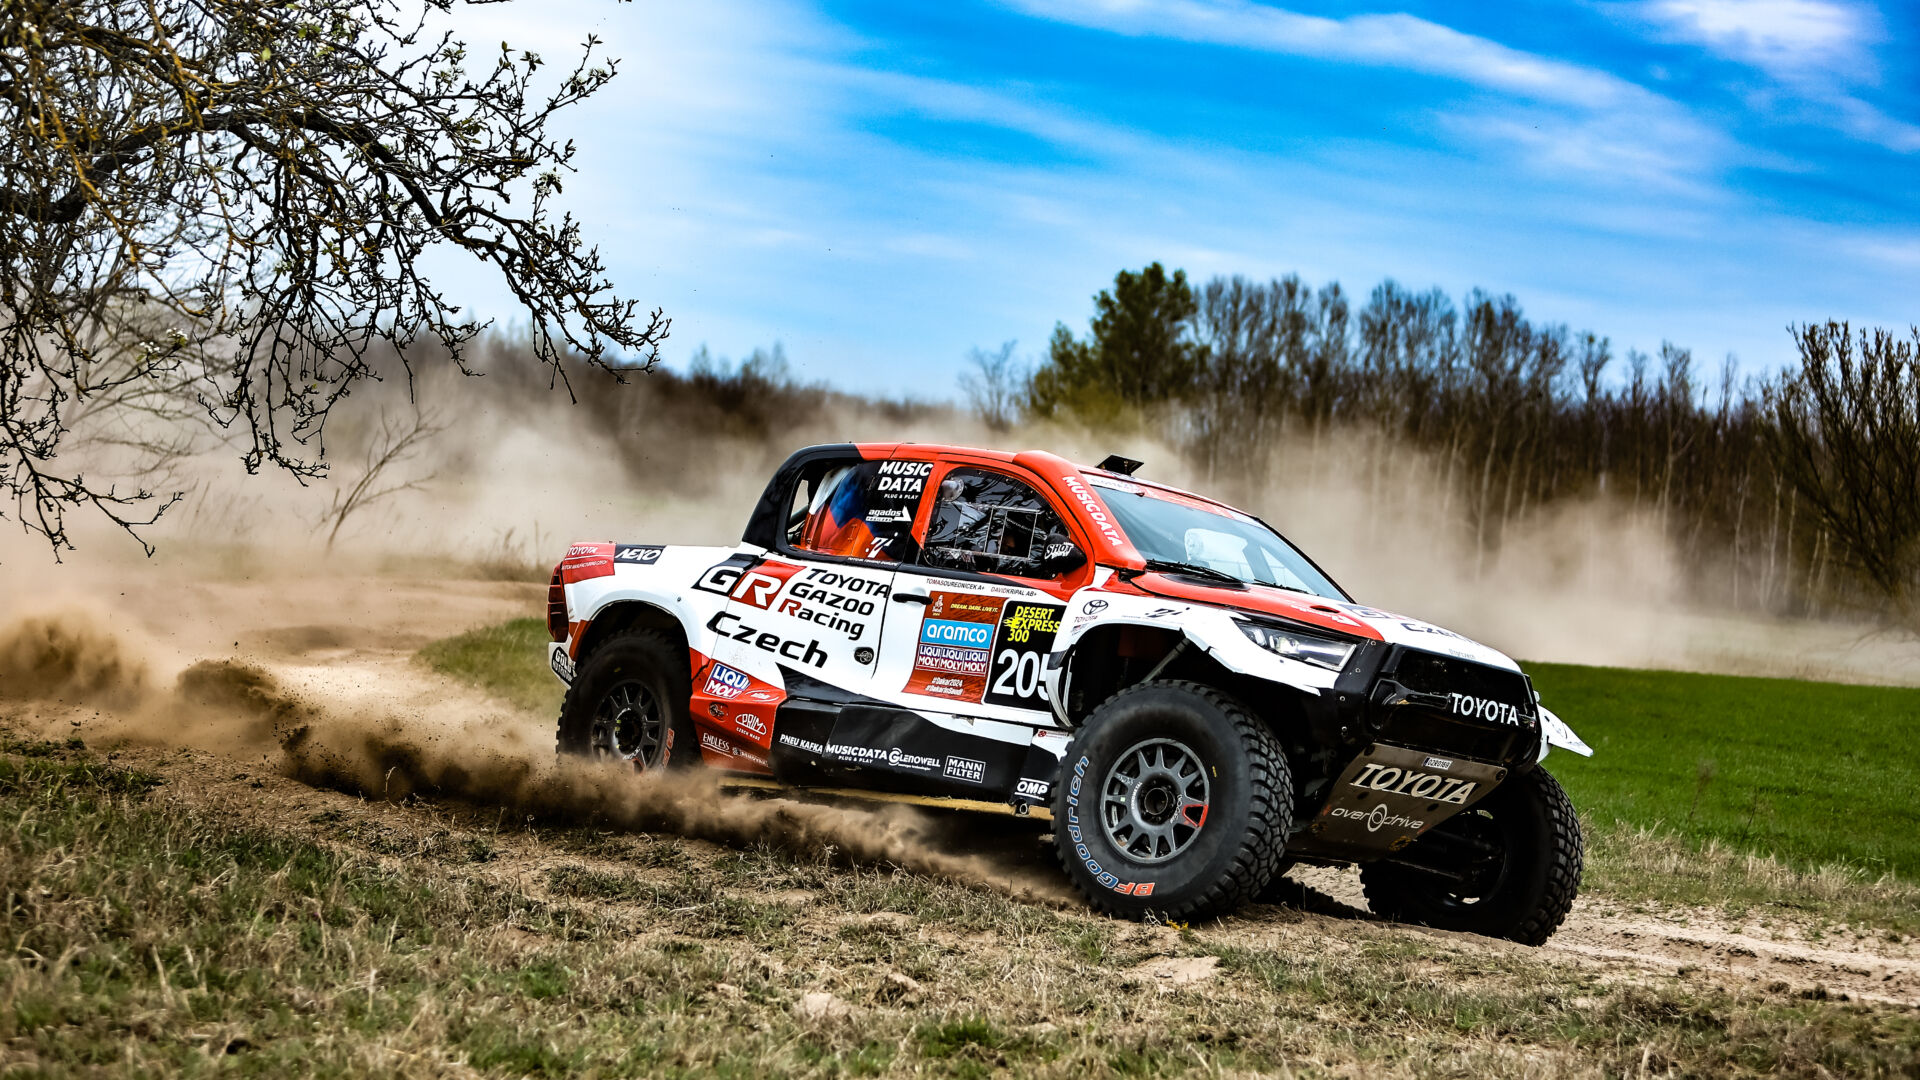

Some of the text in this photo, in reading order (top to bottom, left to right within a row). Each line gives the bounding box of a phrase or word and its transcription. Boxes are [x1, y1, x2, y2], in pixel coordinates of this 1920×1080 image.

[878, 461, 934, 477] MUSIC
[877, 476, 922, 492] DATA
[868, 508, 902, 517] agados
[1062, 475, 1124, 547] MUSICDATA
[567, 545, 597, 555] TOYOTA
[1045, 542, 1074, 559] SHOT
[696, 563, 785, 608] GR
[806, 568, 892, 598] TOYOTA
[789, 582, 875, 616] GAZOO
[778, 598, 865, 641] Racing
[1015, 605, 1055, 620] DESERT
[927, 624, 988, 643] aramco
[1011, 616, 1061, 633] EXPRESS
[707, 610, 829, 669] Czech
[1007, 628, 1030, 643] 300
[920, 645, 987, 662] LIQUI LIQUI LIQUI
[918, 656, 986, 673] MOLY MOLY MOLY
[713, 665, 750, 690] LIQUI
[992, 648, 1051, 701] 205
[706, 681, 742, 699] MOLY
[1451, 692, 1519, 726] TOYOTA
[741, 713, 764, 732] PRIM
[702, 732, 730, 750] ENDLESS
[779, 733, 823, 754] PNEU KAFKA
[825, 744, 888, 761] MUSICDATA
[946, 766, 981, 780] FILTER
[948, 758, 983, 772] MANN
[1017, 780, 1048, 796] OMP
[1349, 763, 1477, 805] TOYOTA
